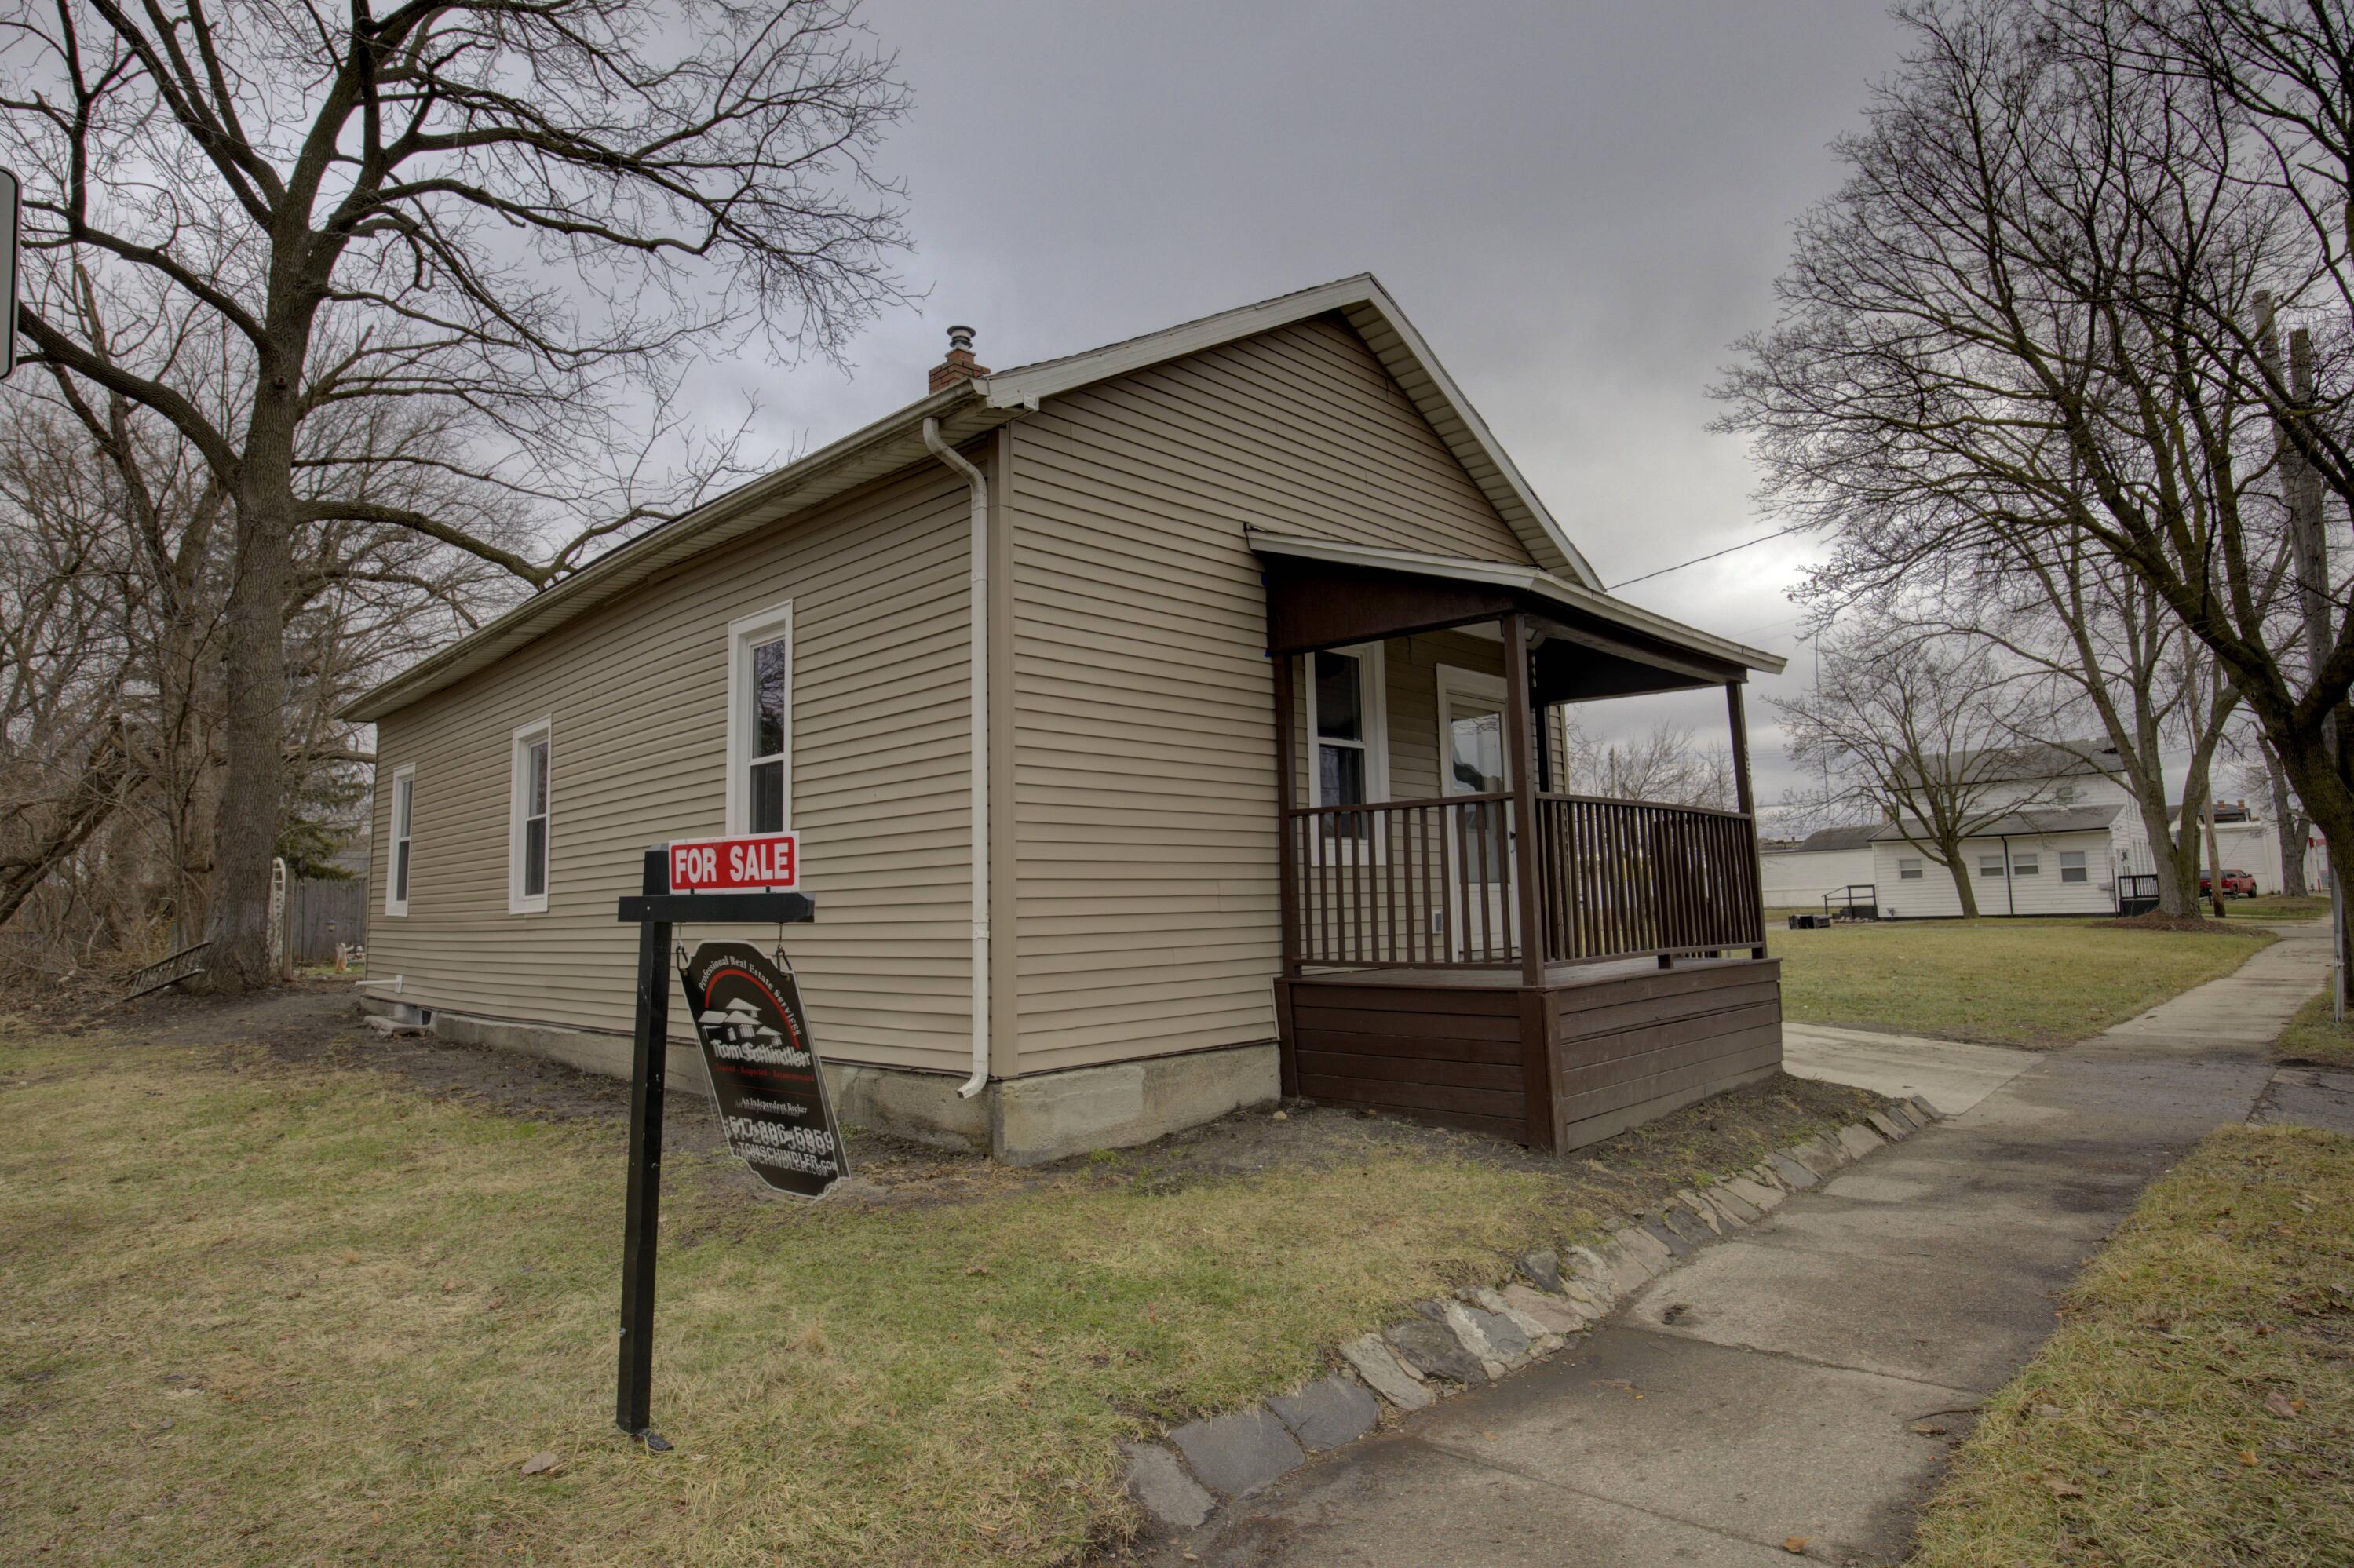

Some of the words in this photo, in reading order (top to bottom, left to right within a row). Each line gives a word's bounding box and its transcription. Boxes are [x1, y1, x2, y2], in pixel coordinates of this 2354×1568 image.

[675, 848, 717, 884] FOR
[730, 842, 789, 882] SALE
[698, 955, 729, 992] Professional
[729, 955, 746, 969] Real
[749, 963, 773, 990] Estate
[773, 989, 801, 1036] Services
[710, 1039, 743, 1059] Tom
[742, 1041, 811, 1067] Schindler
[750, 1097, 786, 1111] Independent
[787, 1103, 808, 1114] Broker
